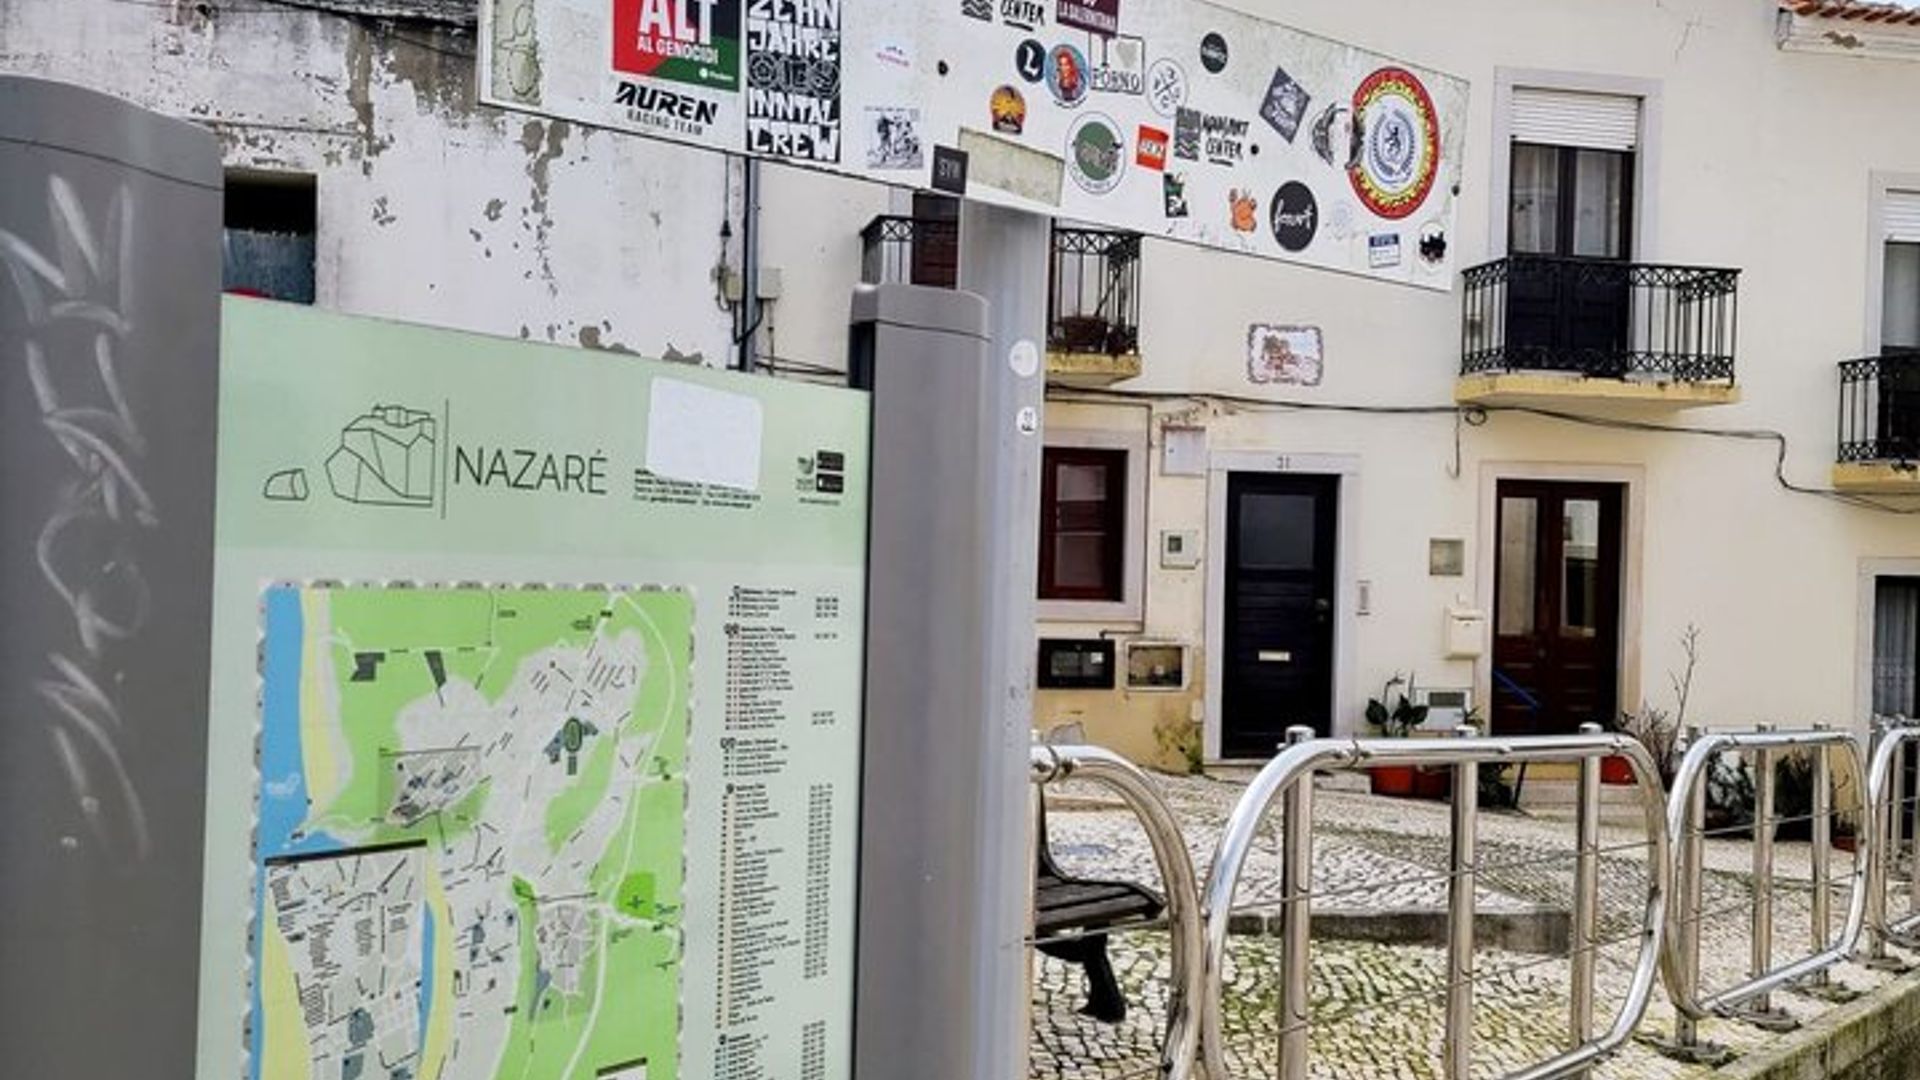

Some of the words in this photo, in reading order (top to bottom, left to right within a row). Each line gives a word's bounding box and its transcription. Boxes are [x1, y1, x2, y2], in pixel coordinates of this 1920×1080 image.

[637, 0, 718, 45] ALT
[750, 0, 839, 29] ZEHN
[637, 35, 655, 53] AL
[656, 38, 718, 64] GENOCIDI
[749, 20, 839, 61] JAHRE
[614, 81, 718, 125] AUREN
[749, 87, 839, 127] INNTAL
[750, 118, 840, 161] CREW
[454, 445, 608, 495] NAZARÉ
